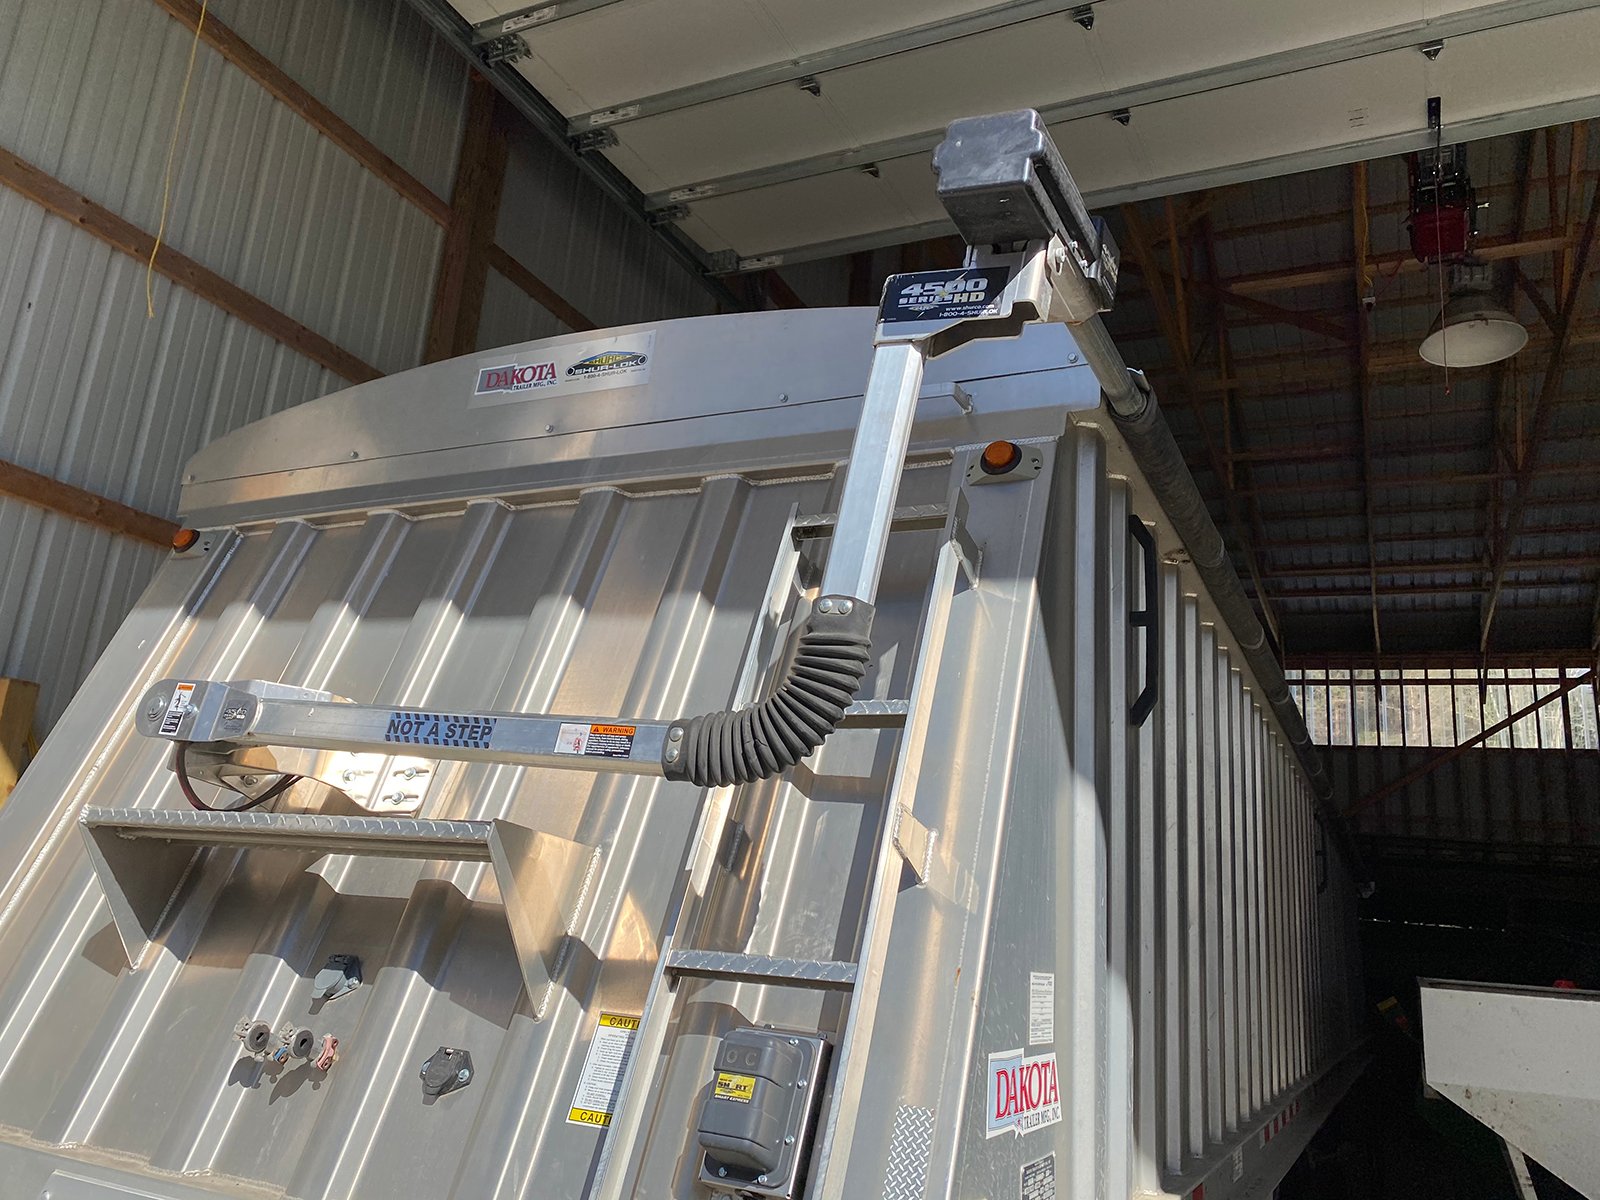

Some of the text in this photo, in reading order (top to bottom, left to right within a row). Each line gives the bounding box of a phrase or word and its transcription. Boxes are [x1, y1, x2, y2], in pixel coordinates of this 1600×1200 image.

[901, 278, 988, 296] 4500
[953, 292, 985, 303] HD
[485, 362, 557, 389] DAKOTA
[574, 360, 638, 375] SHUR-LOK
[386, 719, 493, 740] NOT A STEP
[602, 726, 634, 735] WARNING
[995, 1060, 1059, 1120] DAKOTA
[1023, 1112, 1040, 1130] TRAILER
